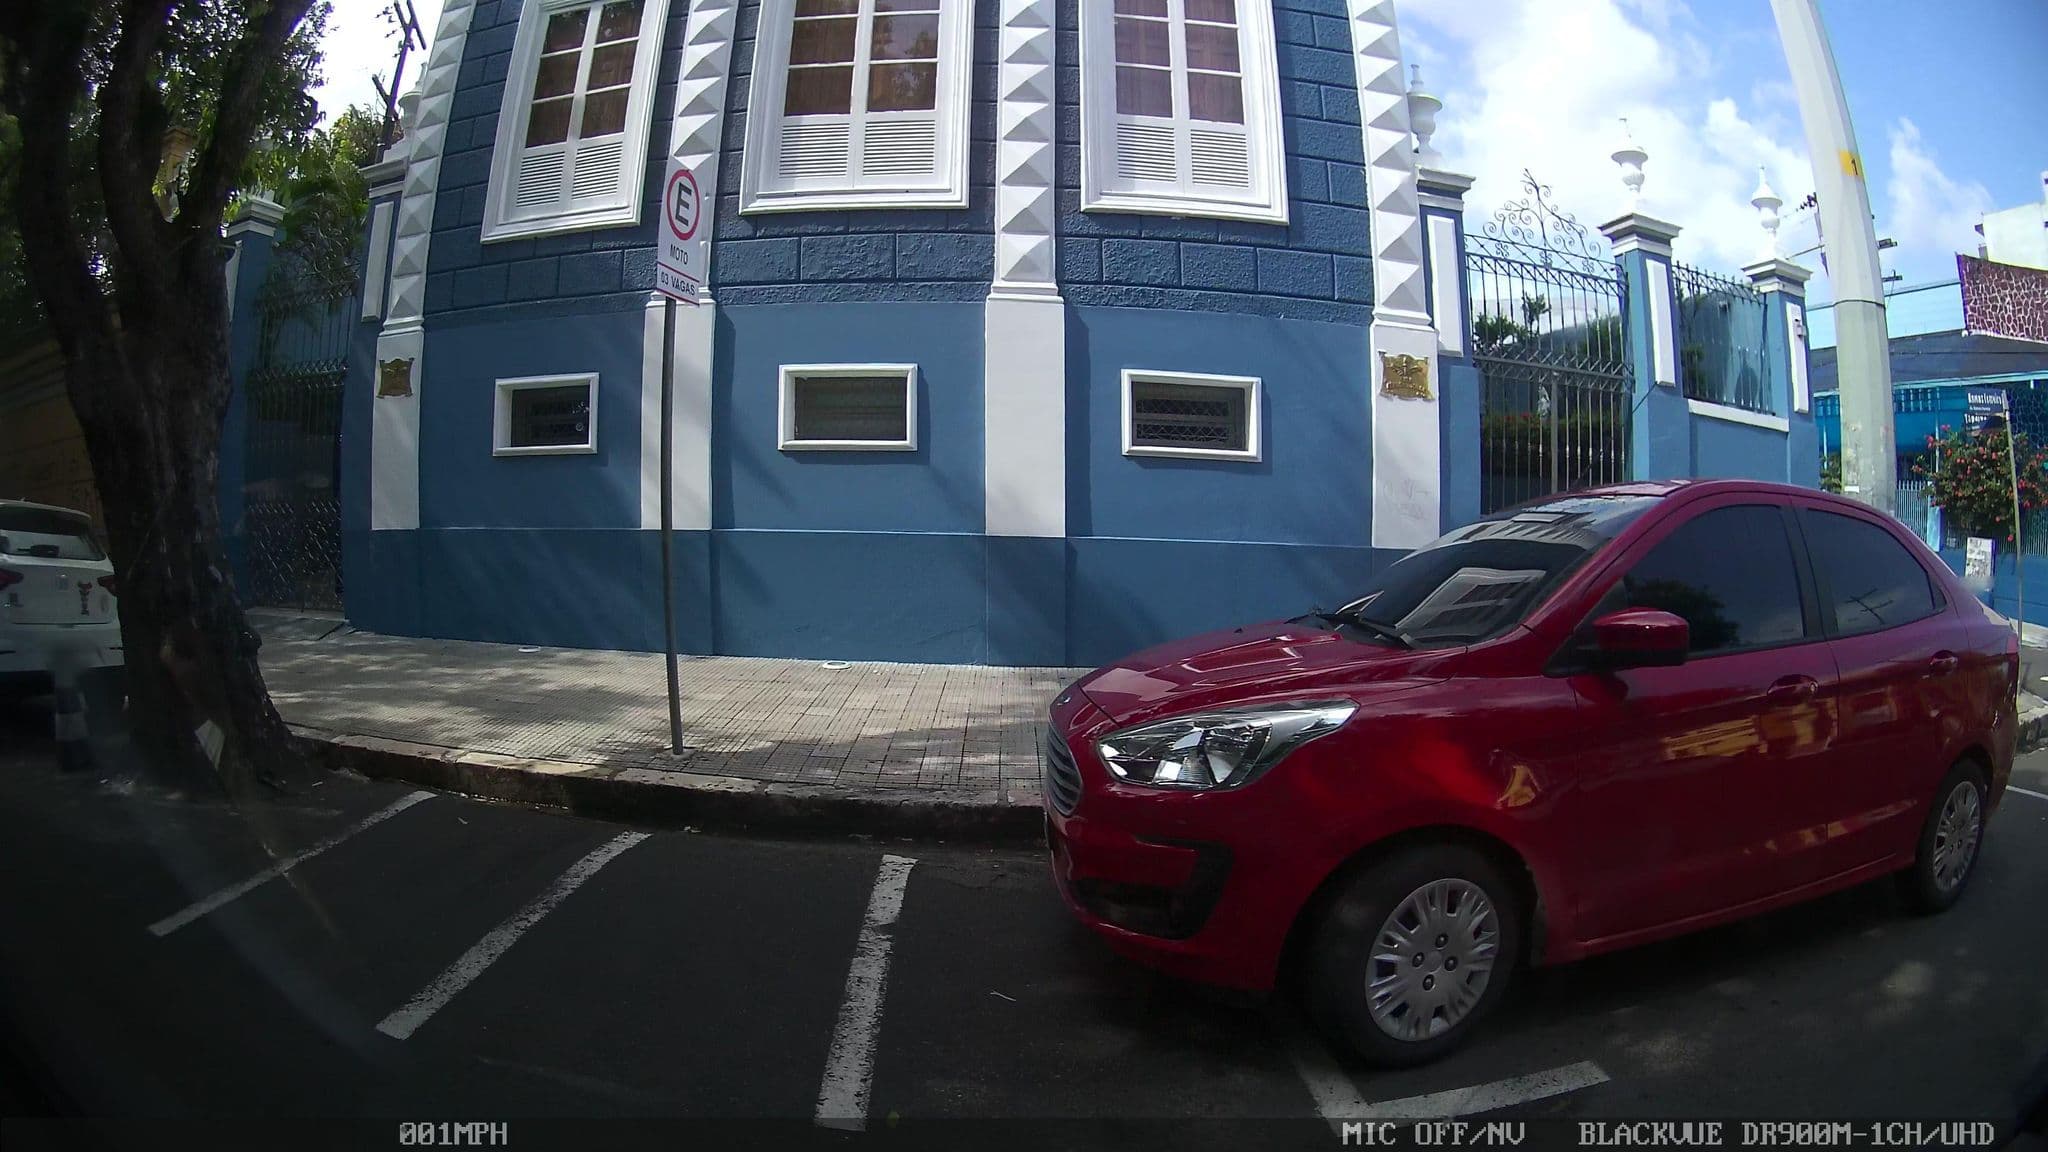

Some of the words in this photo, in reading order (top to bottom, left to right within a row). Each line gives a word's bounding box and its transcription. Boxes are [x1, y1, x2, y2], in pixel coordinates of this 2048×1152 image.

[675, 182, 692, 227] E
[670, 244, 689, 265] MOTO
[671, 275, 696, 296] VAGAS
